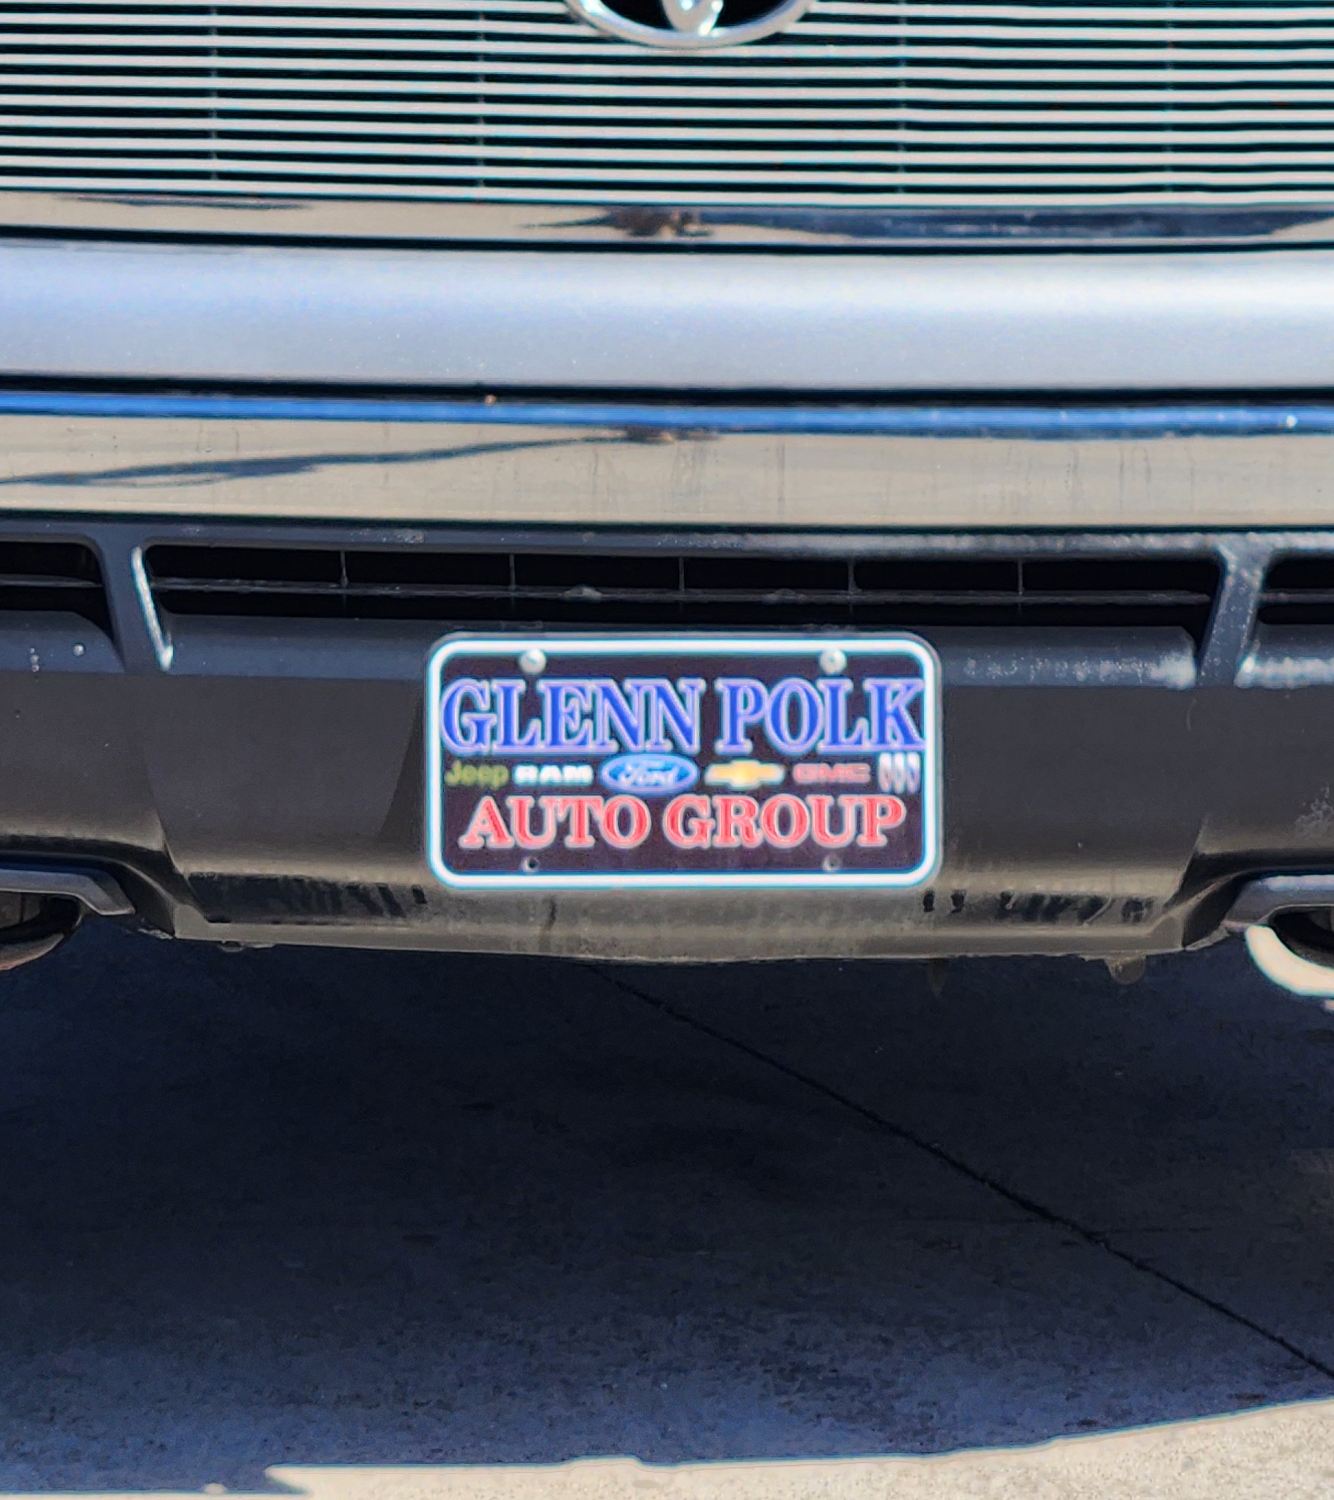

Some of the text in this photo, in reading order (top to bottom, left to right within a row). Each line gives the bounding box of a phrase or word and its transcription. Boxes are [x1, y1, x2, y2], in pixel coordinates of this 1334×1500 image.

[440, 676, 925, 755] GLENN POLK
[445, 758, 871, 790] Jeep RAM Ford GMC
[458, 795, 907, 849] AUTO GROUP
